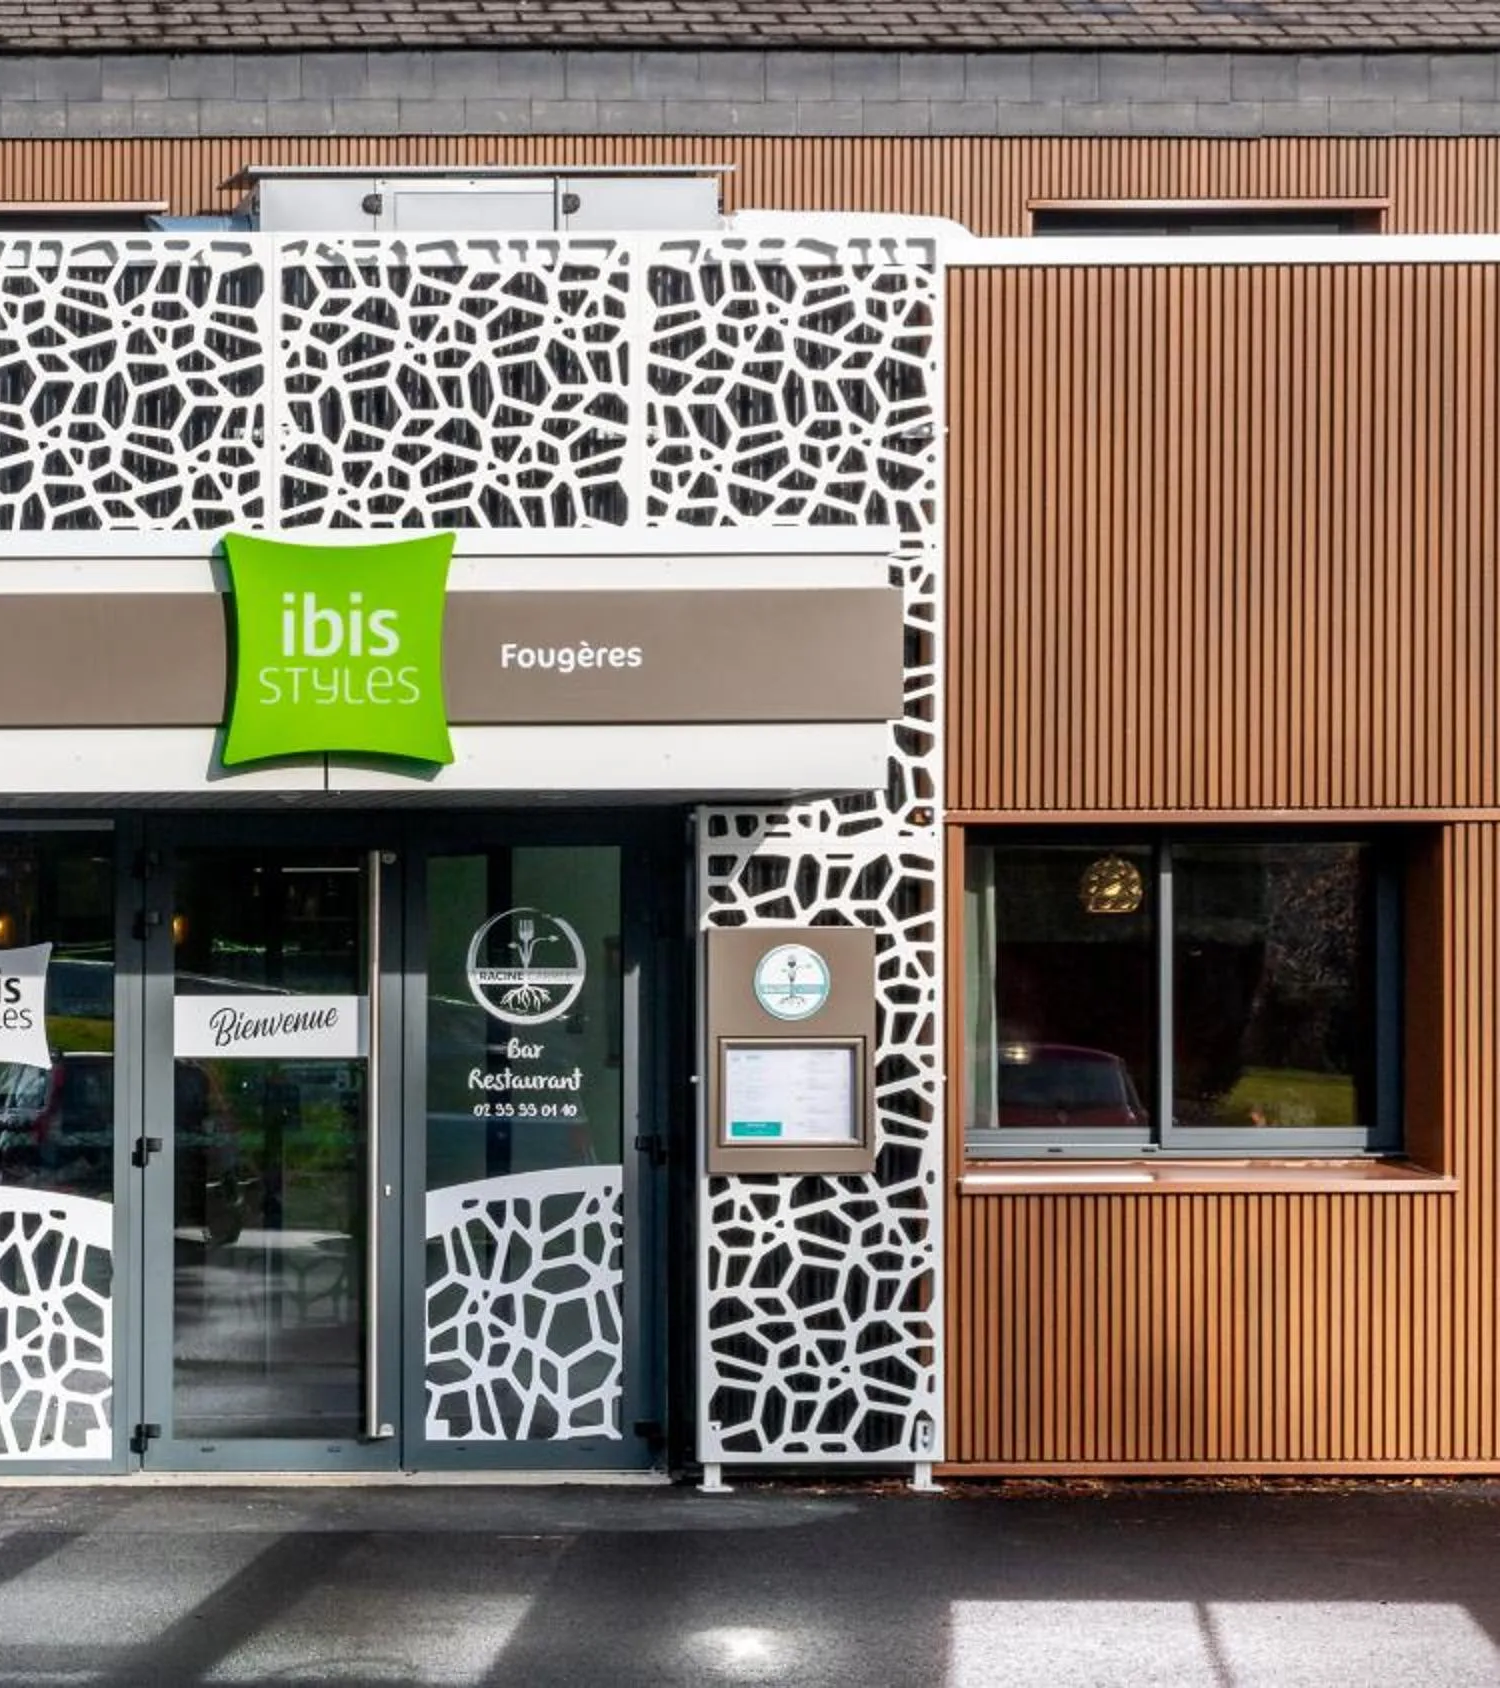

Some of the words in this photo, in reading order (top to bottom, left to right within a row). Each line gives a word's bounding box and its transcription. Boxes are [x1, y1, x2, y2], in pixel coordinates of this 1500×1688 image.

[281, 591, 400, 657] ibis
[501, 640, 642, 673] Fougères
[479, 971, 525, 981] RACINE
[209, 1006, 338, 1047] Bienvenue
[506, 1037, 545, 1059] Bar
[468, 1067, 583, 1091] Restaurant
[473, 1103, 491, 1117] 02
[541, 1103, 558, 1117] 01
